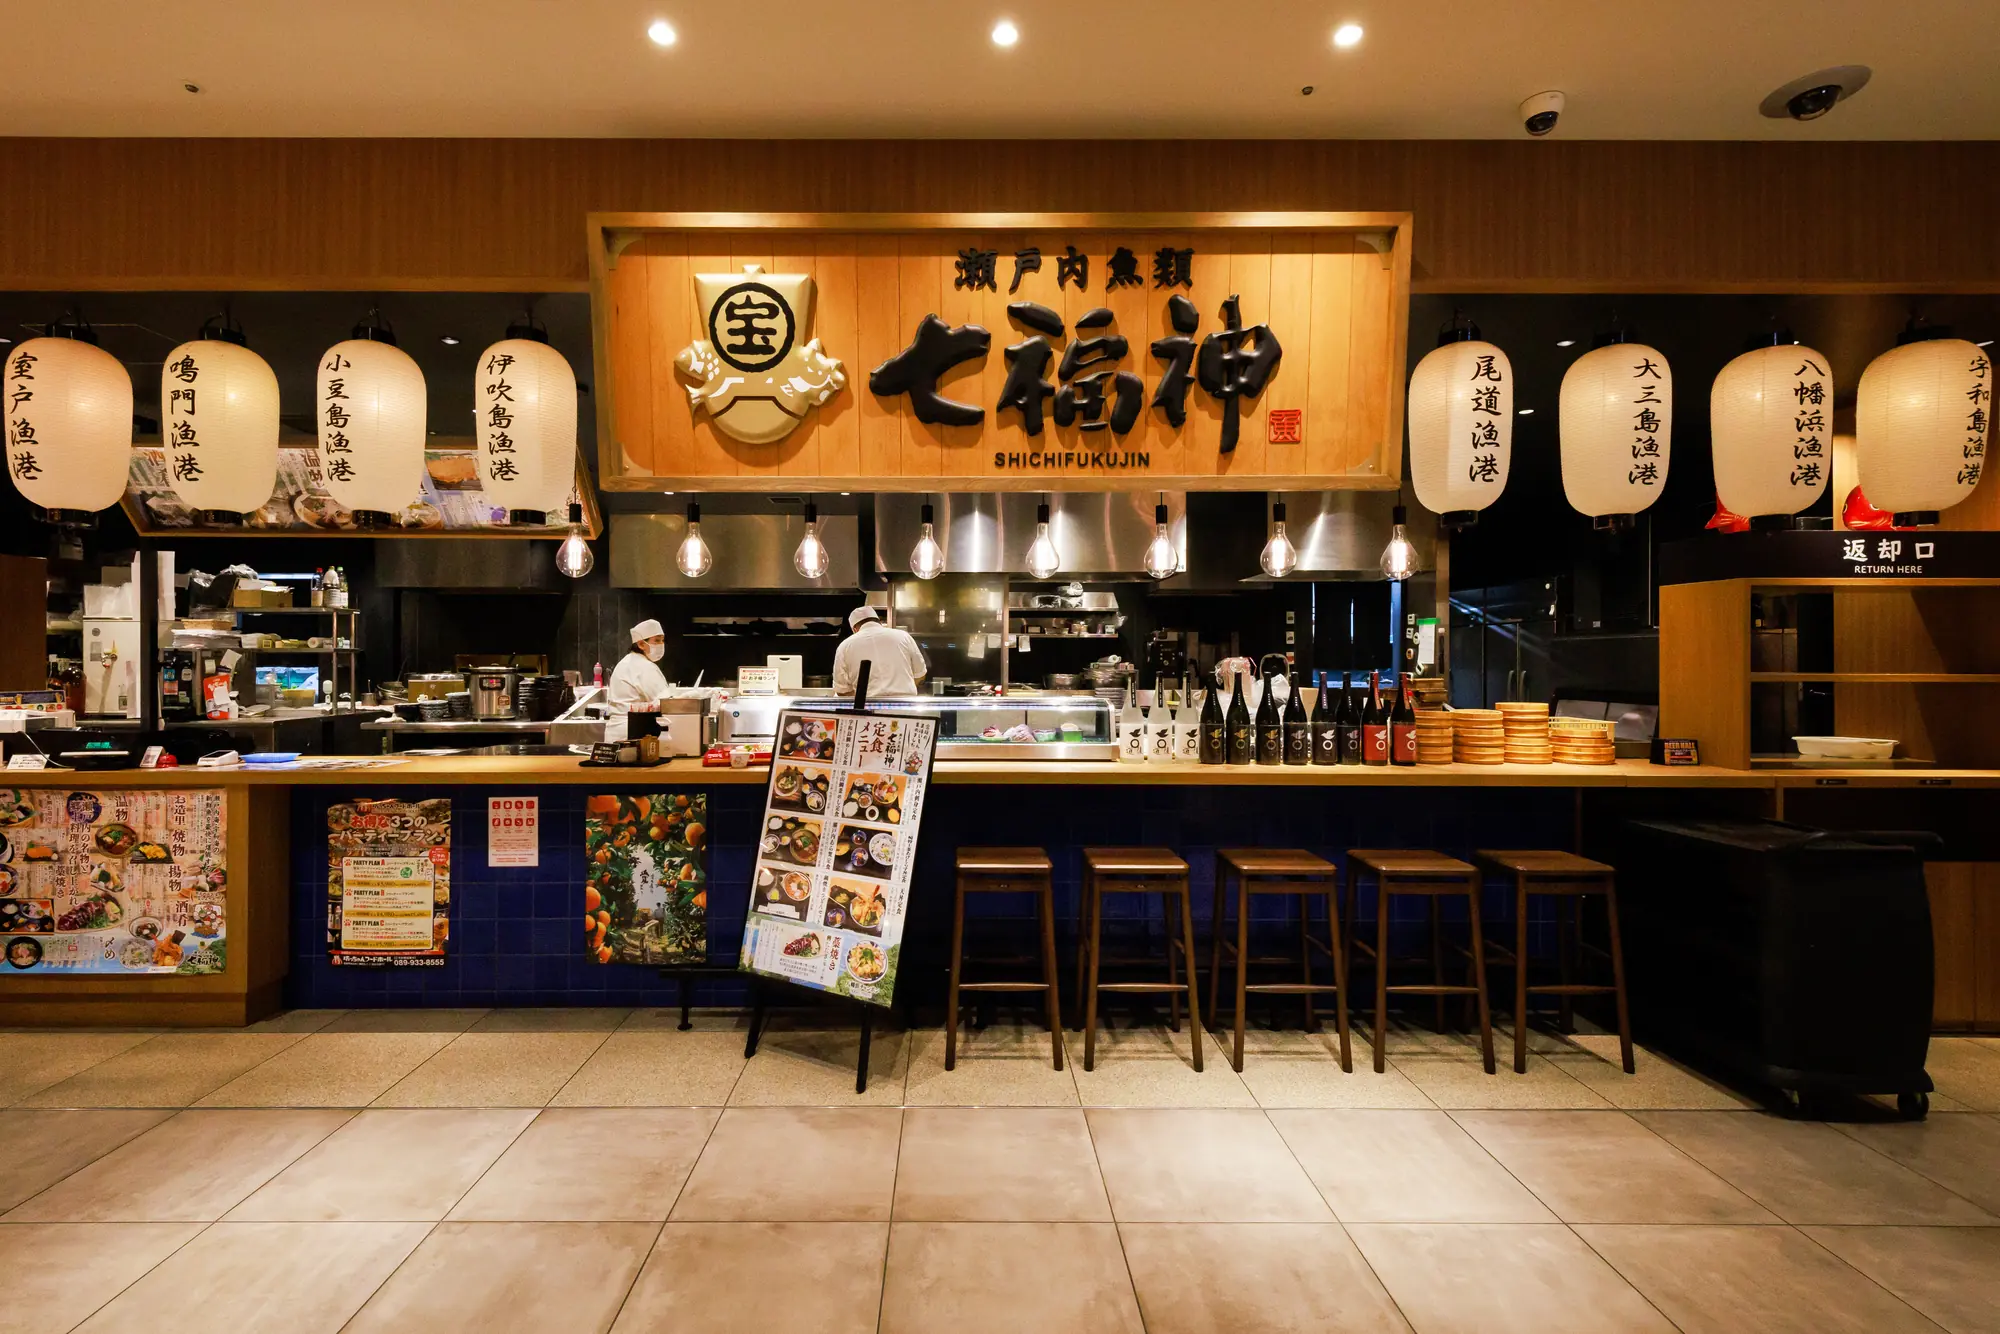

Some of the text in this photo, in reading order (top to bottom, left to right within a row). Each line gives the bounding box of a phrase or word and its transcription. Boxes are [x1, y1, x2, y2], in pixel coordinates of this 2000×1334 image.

[953, 246, 1193, 290] 瀬戸内魚類
[869, 293, 1283, 454] 七福神
[9, 351, 43, 481] 室戸漁港
[169, 354, 204, 483] 鳴門漁港
[323, 353, 357, 484] 小豆島漁港
[485, 354, 519, 483] 伊吹島漁港
[1468, 355, 1503, 485] 尾道漁港
[1627, 357, 1662, 487] 大三島漁港
[1789, 358, 1827, 488] 八幡浜漁港
[1956, 355, 1993, 487] 宇和島漁港
[993, 451, 1151, 469] SHICHIFUKUJIN
[1842, 538, 1935, 563] 返却口
[1854, 565, 1924, 575] RETURN HERE
[858, 721, 871, 768] メニュー
[869, 721, 887, 753] 定食
[884, 733, 898, 768] 七福神
[172, 829, 186, 857] 焼物
[350, 815, 429, 829] お得な3つの
[168, 865, 182, 892] 揚物
[393, 958, 445, 967] 089-933-8555
